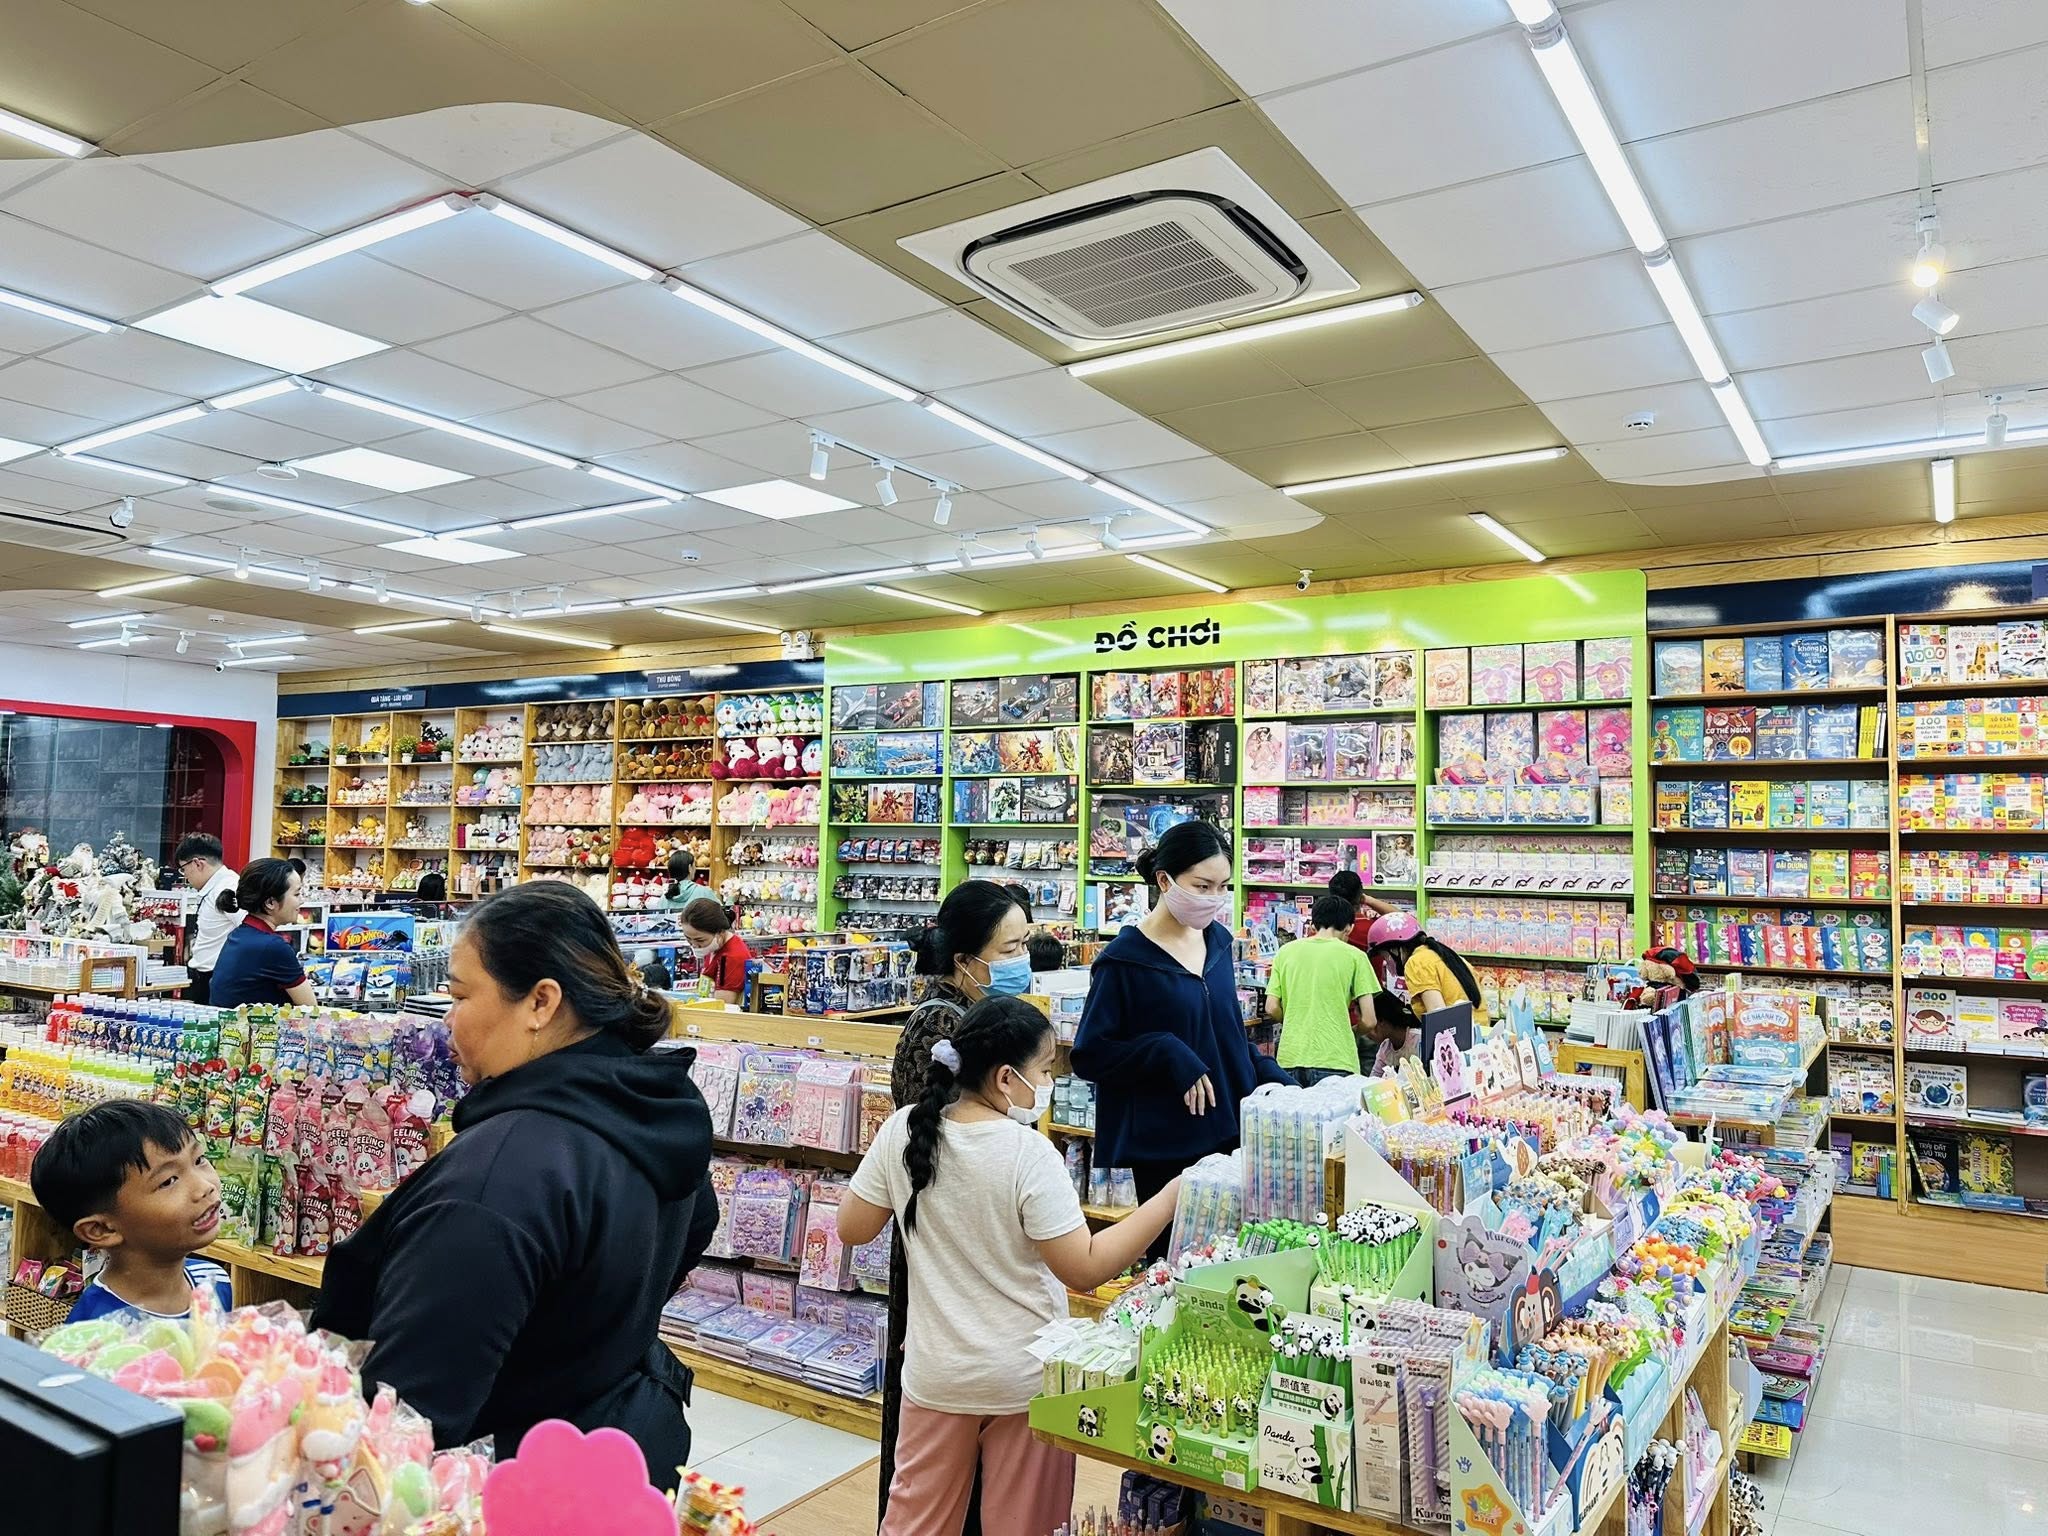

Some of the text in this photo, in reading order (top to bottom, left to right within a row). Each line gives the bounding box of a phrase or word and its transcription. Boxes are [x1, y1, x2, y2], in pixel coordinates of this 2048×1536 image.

[1094, 618, 1220, 653] ĐỒ CHƠI
[2022, 700, 2031, 711] 2
[1914, 992, 1947, 1001] 4000
[394, 1128, 424, 1141] EELING
[400, 1138, 422, 1150] Candy
[364, 1146, 386, 1158] Candy
[220, 1183, 246, 1195] ELING
[303, 1198, 328, 1211] EELING
[334, 1208, 358, 1222] EELING
[1191, 1296, 1225, 1312] Panda
[1280, 1378, 1310, 1394] 颜值笔
[1360, 1377, 1390, 1388] 自动铅笔
[1264, 1425, 1296, 1443] Panda
[1416, 1508, 1451, 1522] Kurom
